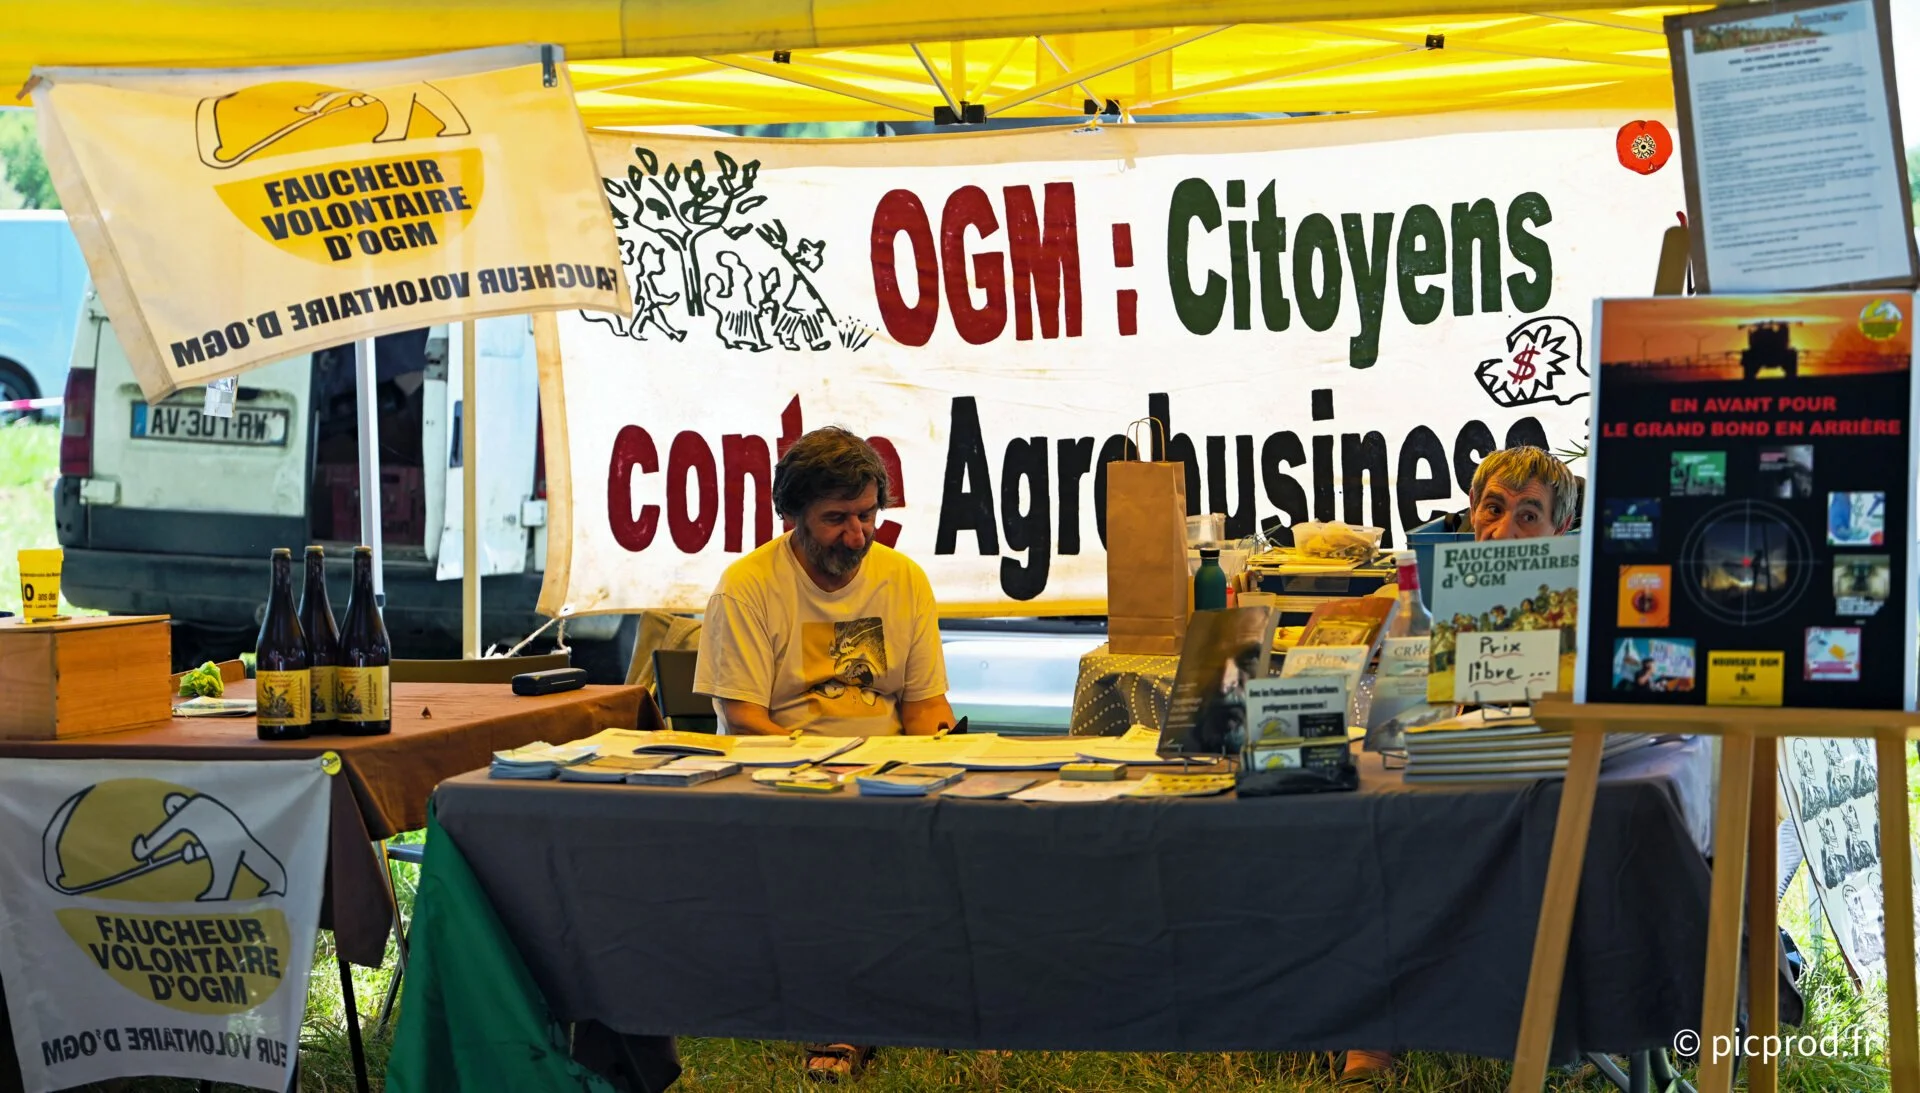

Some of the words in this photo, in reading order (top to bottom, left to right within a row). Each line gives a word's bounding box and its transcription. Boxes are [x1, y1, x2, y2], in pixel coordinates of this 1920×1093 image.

[264, 159, 444, 208] FAUCHEUR
[261, 186, 472, 241] VOLONTAIRE
[323, 221, 438, 261] D'OGM
[870, 182, 1083, 347] OGM
[1167, 177, 1553, 369] Citoyens
[1670, 398, 1697, 414] EN
[1704, 397, 1773, 413] AVANT
[1778, 396, 1837, 412] POUR
[1603, 422, 1628, 437] LE
[1633, 421, 1705, 437] GRAND
[1711, 421, 1770, 436] BOND
[1775, 420, 1802, 436] EN
[1809, 417, 1902, 435] ARRIÈRE
[607, 393, 905, 554] con
[935, 388, 1549, 601] Agrbusines
[1443, 543, 1550, 569] FAUCHEURS
[1457, 554, 1579, 576] VOLONTAIRES
[1479, 636, 1521, 654] Prix
[1468, 661, 1522, 683] libre
[95, 915, 267, 944] FAUCHEUR
[88, 943, 281, 978] VOLONTAIRE
[149, 974, 248, 1005] D'OGM
